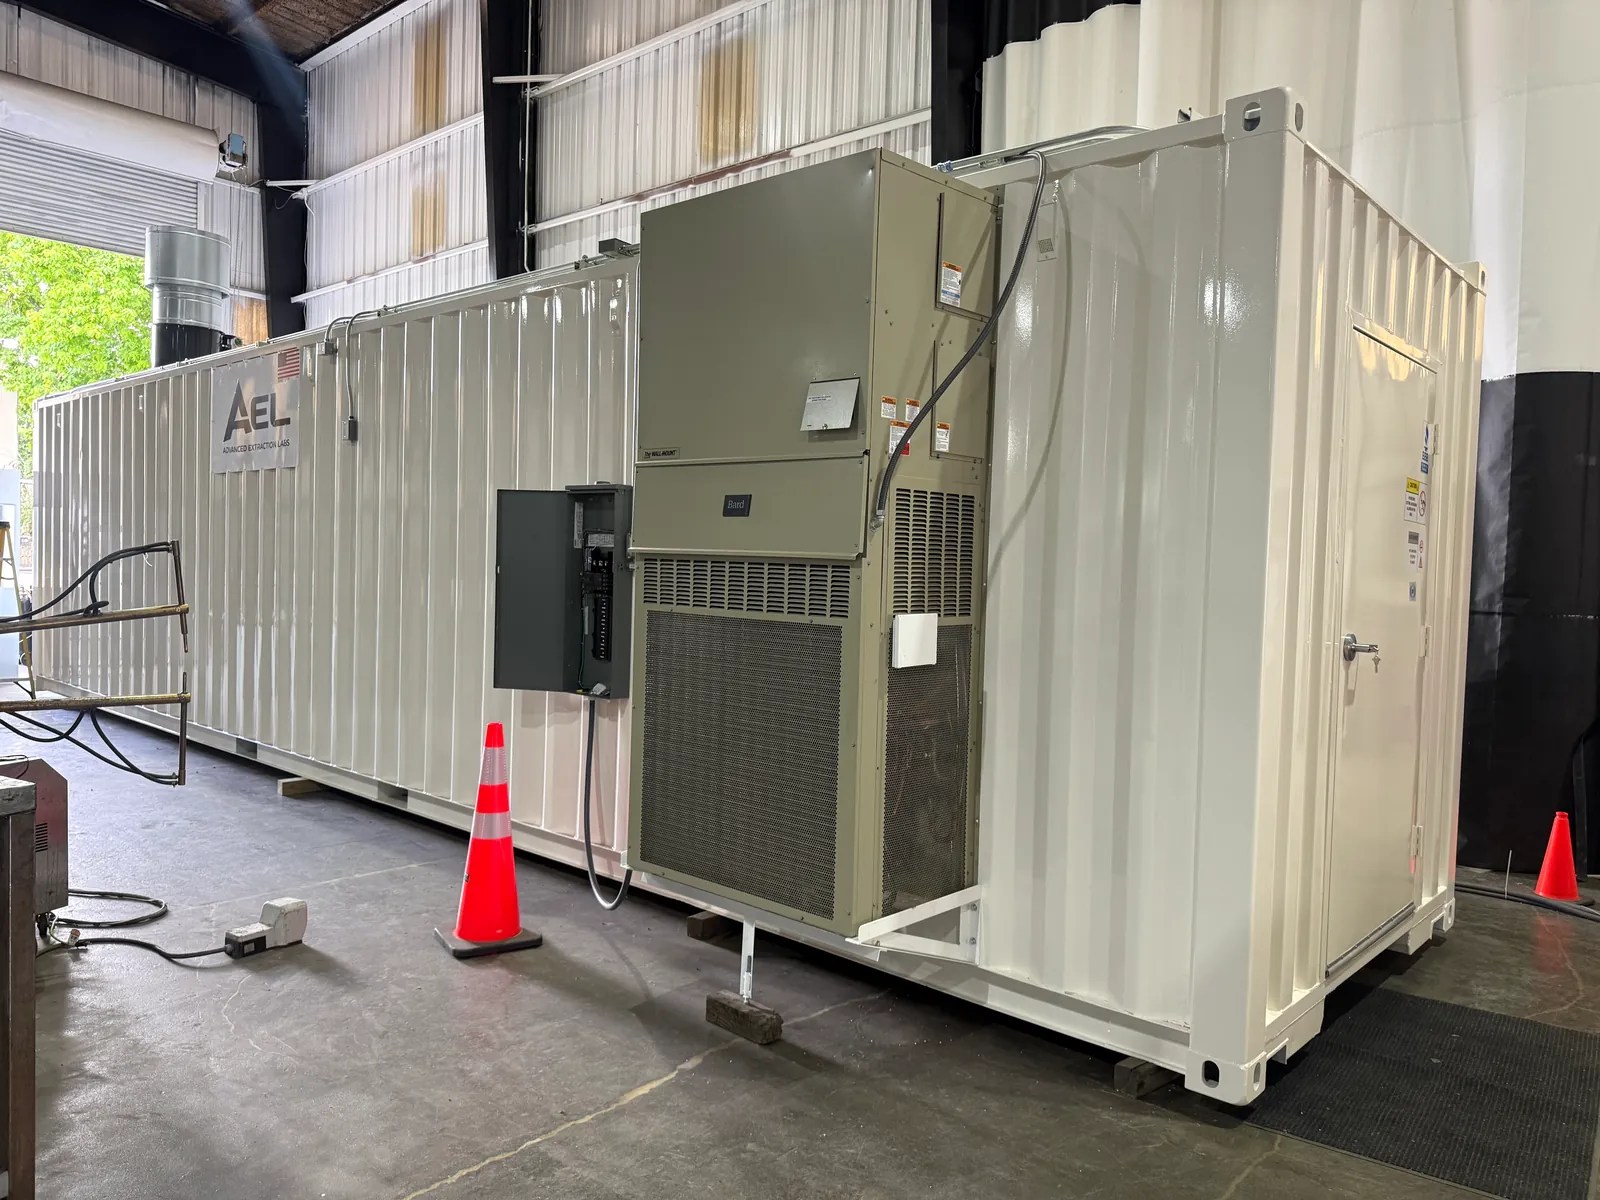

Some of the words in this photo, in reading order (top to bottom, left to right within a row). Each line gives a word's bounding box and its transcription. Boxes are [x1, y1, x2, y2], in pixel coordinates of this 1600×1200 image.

[223, 381, 290, 442] AEL
[223, 444, 248, 454] ADVANCED
[248, 441, 277, 452] EXTRACTION
[278, 439, 290, 448] LABS
[727, 500, 745, 509] Bard
